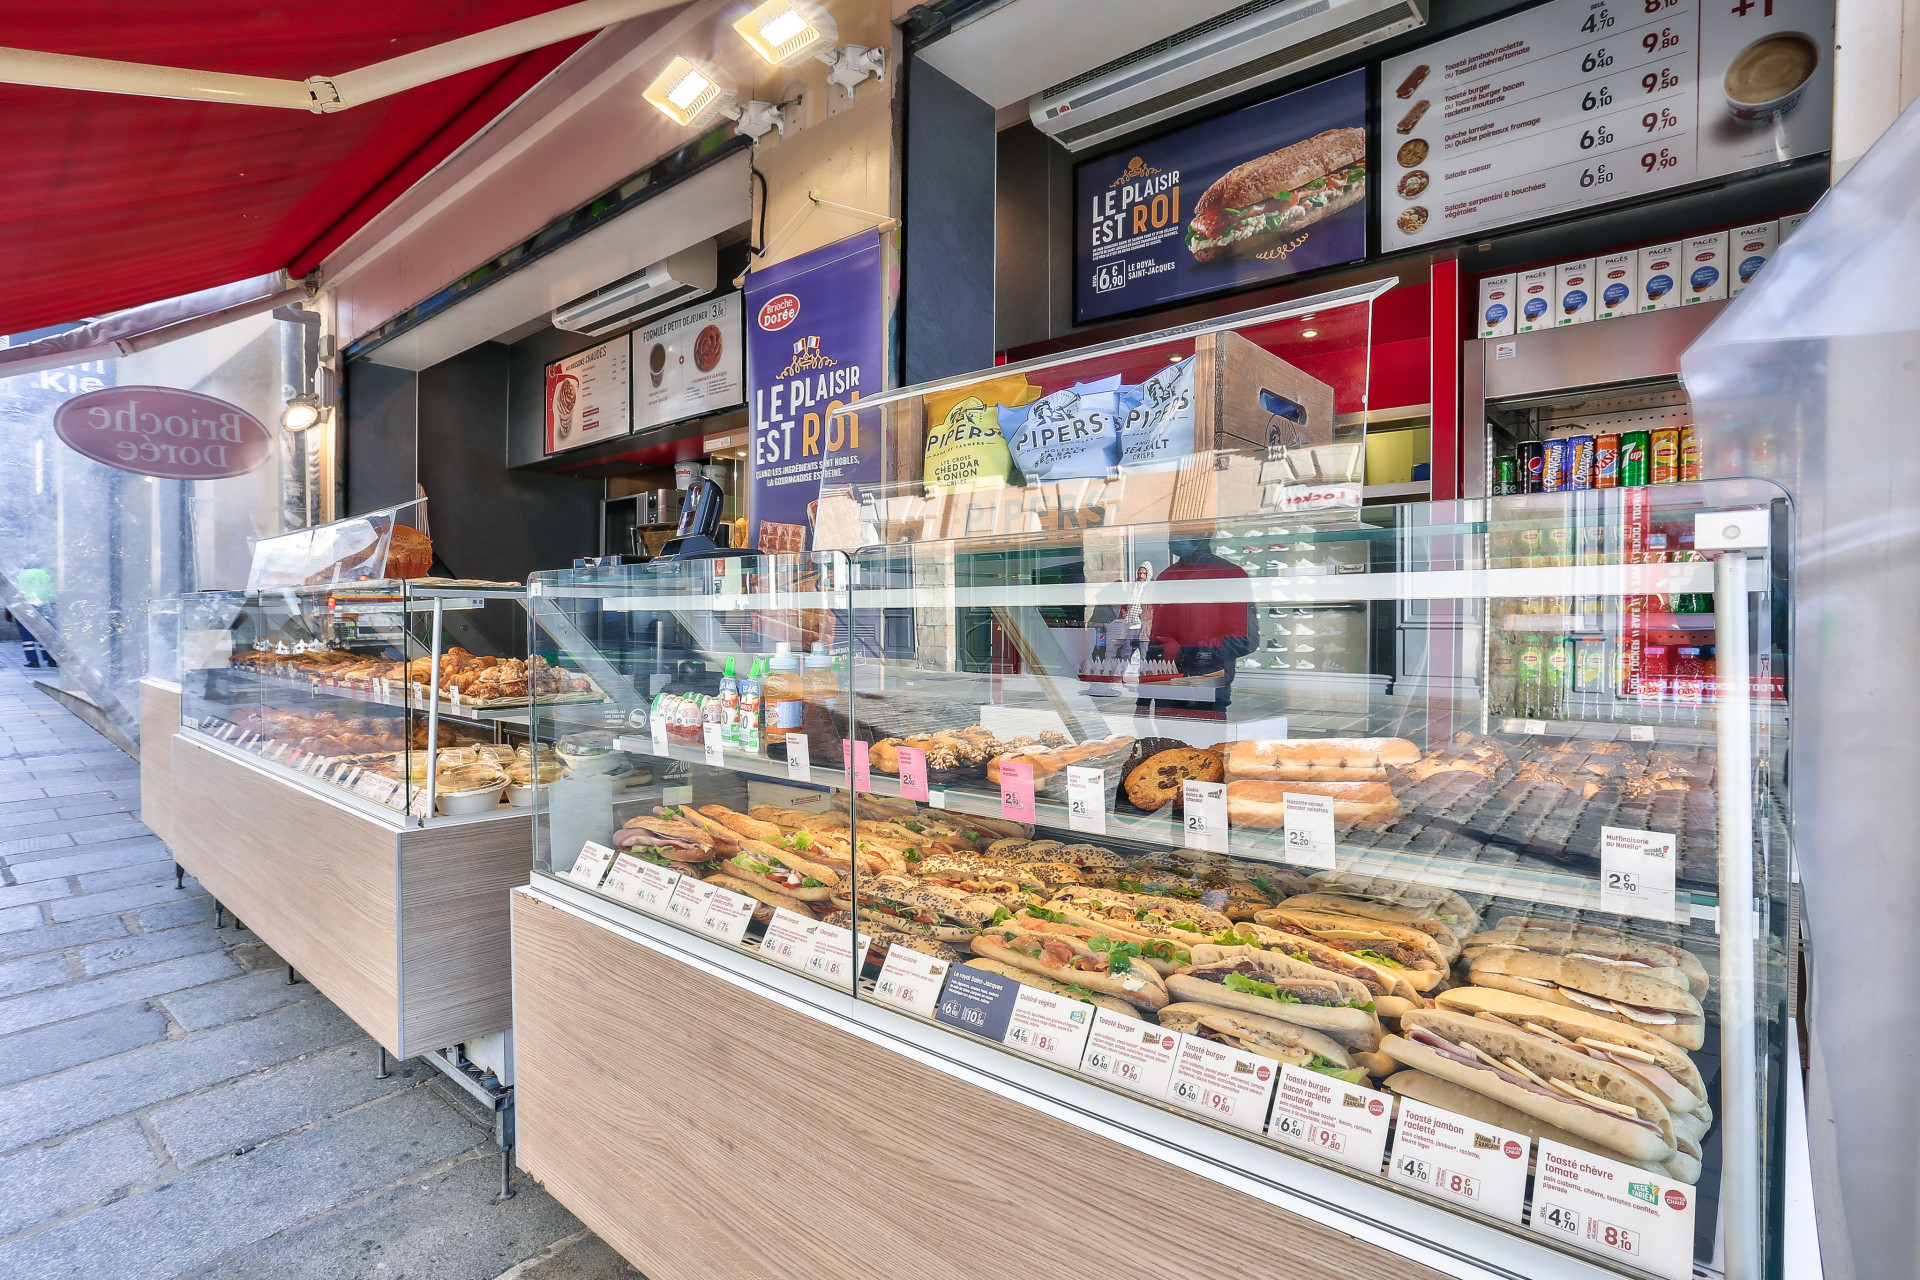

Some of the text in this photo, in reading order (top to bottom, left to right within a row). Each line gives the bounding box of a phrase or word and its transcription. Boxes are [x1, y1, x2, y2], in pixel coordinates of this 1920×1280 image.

[1444, 58, 1466, 72] Toasté
[1455, 63, 1477, 76] Toasté
[1444, 84, 1490, 102] Toasté burger
[1455, 94, 1477, 108] Toasté
[1479, 88, 1501, 101] burger
[1503, 81, 1525, 92] bacon
[1444, 95, 1506, 118] raclette moutarde
[1444, 122, 1494, 142] Quiche lorraine
[1454, 136, 1477, 147] Quiche
[1479, 126, 1508, 141] poireaux
[1511, 118, 1541, 130] fromage
[1444, 163, 1492, 180] Salade caesar
[1092, 170, 1180, 224] LE PLAISIR
[1444, 202, 1467, 212] Salade
[1469, 192, 1502, 206] serpentini
[1512, 182, 1546, 196] bouchées
[1092, 212, 1126, 246] EST
[1133, 186, 1180, 234] ROI
[1444, 206, 1477, 219] végétales
[1692, 237, 1718, 247] PAGÈS
[1648, 247, 1673, 256] PAGÈS
[1128, 258, 1156, 272] LE ROYAL
[1564, 264, 1586, 272] PAGÈS
[1605, 256, 1628, 264] PAGÈS
[1128, 262, 1176, 280] SAINT-JACQUES
[1526, 272, 1546, 280] PAGÈS
[766, 298, 793, 314] Brioche
[764, 308, 795, 326] Dorée
[644, 320, 681, 343] FORMULE PETIT
[757, 384, 784, 430] LE
[790, 366, 860, 416] PLAISIR
[756, 390, 860, 465] EST ROI
[1124, 446, 1141, 455] SEA
[1133, 452, 1154, 460] CRISPS
[952, 455, 971, 463] CROSS
[1544, 445, 1563, 486] ORANGINA
[1573, 441, 1594, 483] ORANGINA
[756, 468, 772, 480] QUAND
[772, 467, 782, 475] LES
[782, 461, 818, 474] INGRÉDIENTS
[819, 459, 834, 468] SNT
[934, 460, 980, 475] CHEDDAR
[944, 468, 977, 480] ONION
[766, 478, 774, 487] LA
[774, 472, 812, 486] GOURMANDISE
[1606, 834, 1649, 845] Muffinoiserie
[1020, 994, 1056, 1009] Cuisiné végétal
[1099, 1017, 1135, 1033] Toasté burger
[1182, 1051, 1202, 1061] poulet
[1185, 1042, 1226, 1061] Toasté burger
[1286, 1073, 1331, 1093] Toasté burger
[1281, 1092, 1313, 1108] moutarde
[1283, 1083, 1331, 1104] bacon raclette
[1404, 1120, 1436, 1136] raclette
[1406, 1110, 1464, 1135] Toasté jambon
[1417, 1141, 1430, 1150] léger
[1545, 1163, 1579, 1180] tomate
[1546, 1152, 1613, 1180] Toasté chèvre
[1543, 1182, 1568, 1194] piperade
[1557, 1178, 1582, 1192] ciabatta,
[1584, 1187, 1606, 1199] chèvre,
[1606, 1194, 1632, 1208] tomates
[1632, 1189, 1655, 1203] TARIEN
